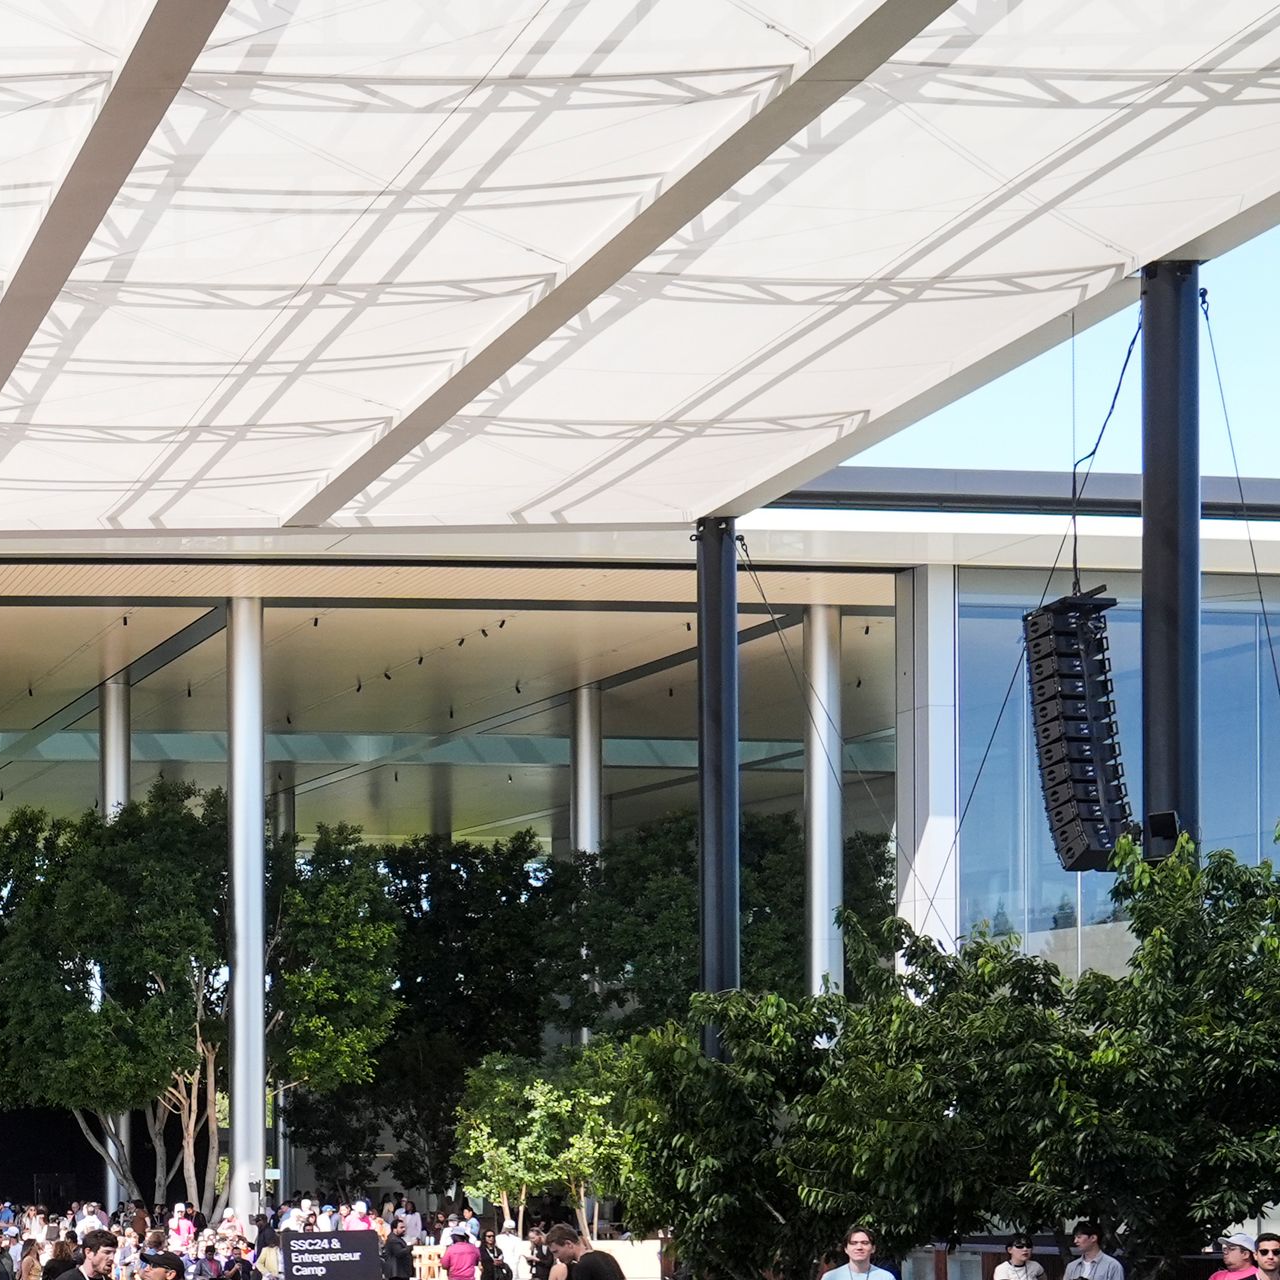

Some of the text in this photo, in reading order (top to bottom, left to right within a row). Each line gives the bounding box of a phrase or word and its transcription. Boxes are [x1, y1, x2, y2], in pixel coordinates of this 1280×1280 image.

[290, 1238, 341, 1250] SSC24 &
[291, 1252, 362, 1264] Entrepreneur
[292, 1265, 327, 1277] Camp
